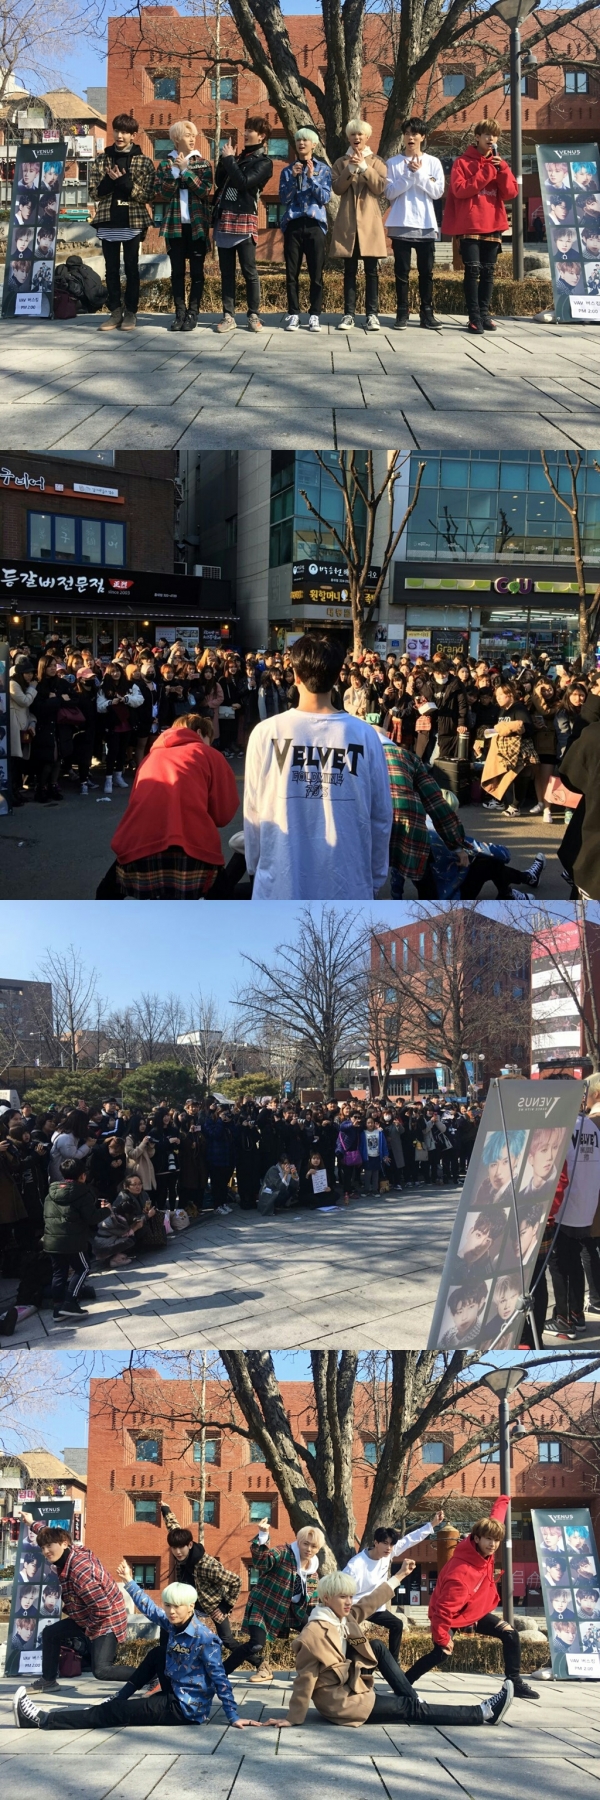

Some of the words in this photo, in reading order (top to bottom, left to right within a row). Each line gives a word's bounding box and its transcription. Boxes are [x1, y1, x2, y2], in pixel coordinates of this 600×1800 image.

[1, 568, 105, 593] 등갈비전문점
[436, 643, 464, 653] Grand
[271, 738, 365, 778] VELVET
